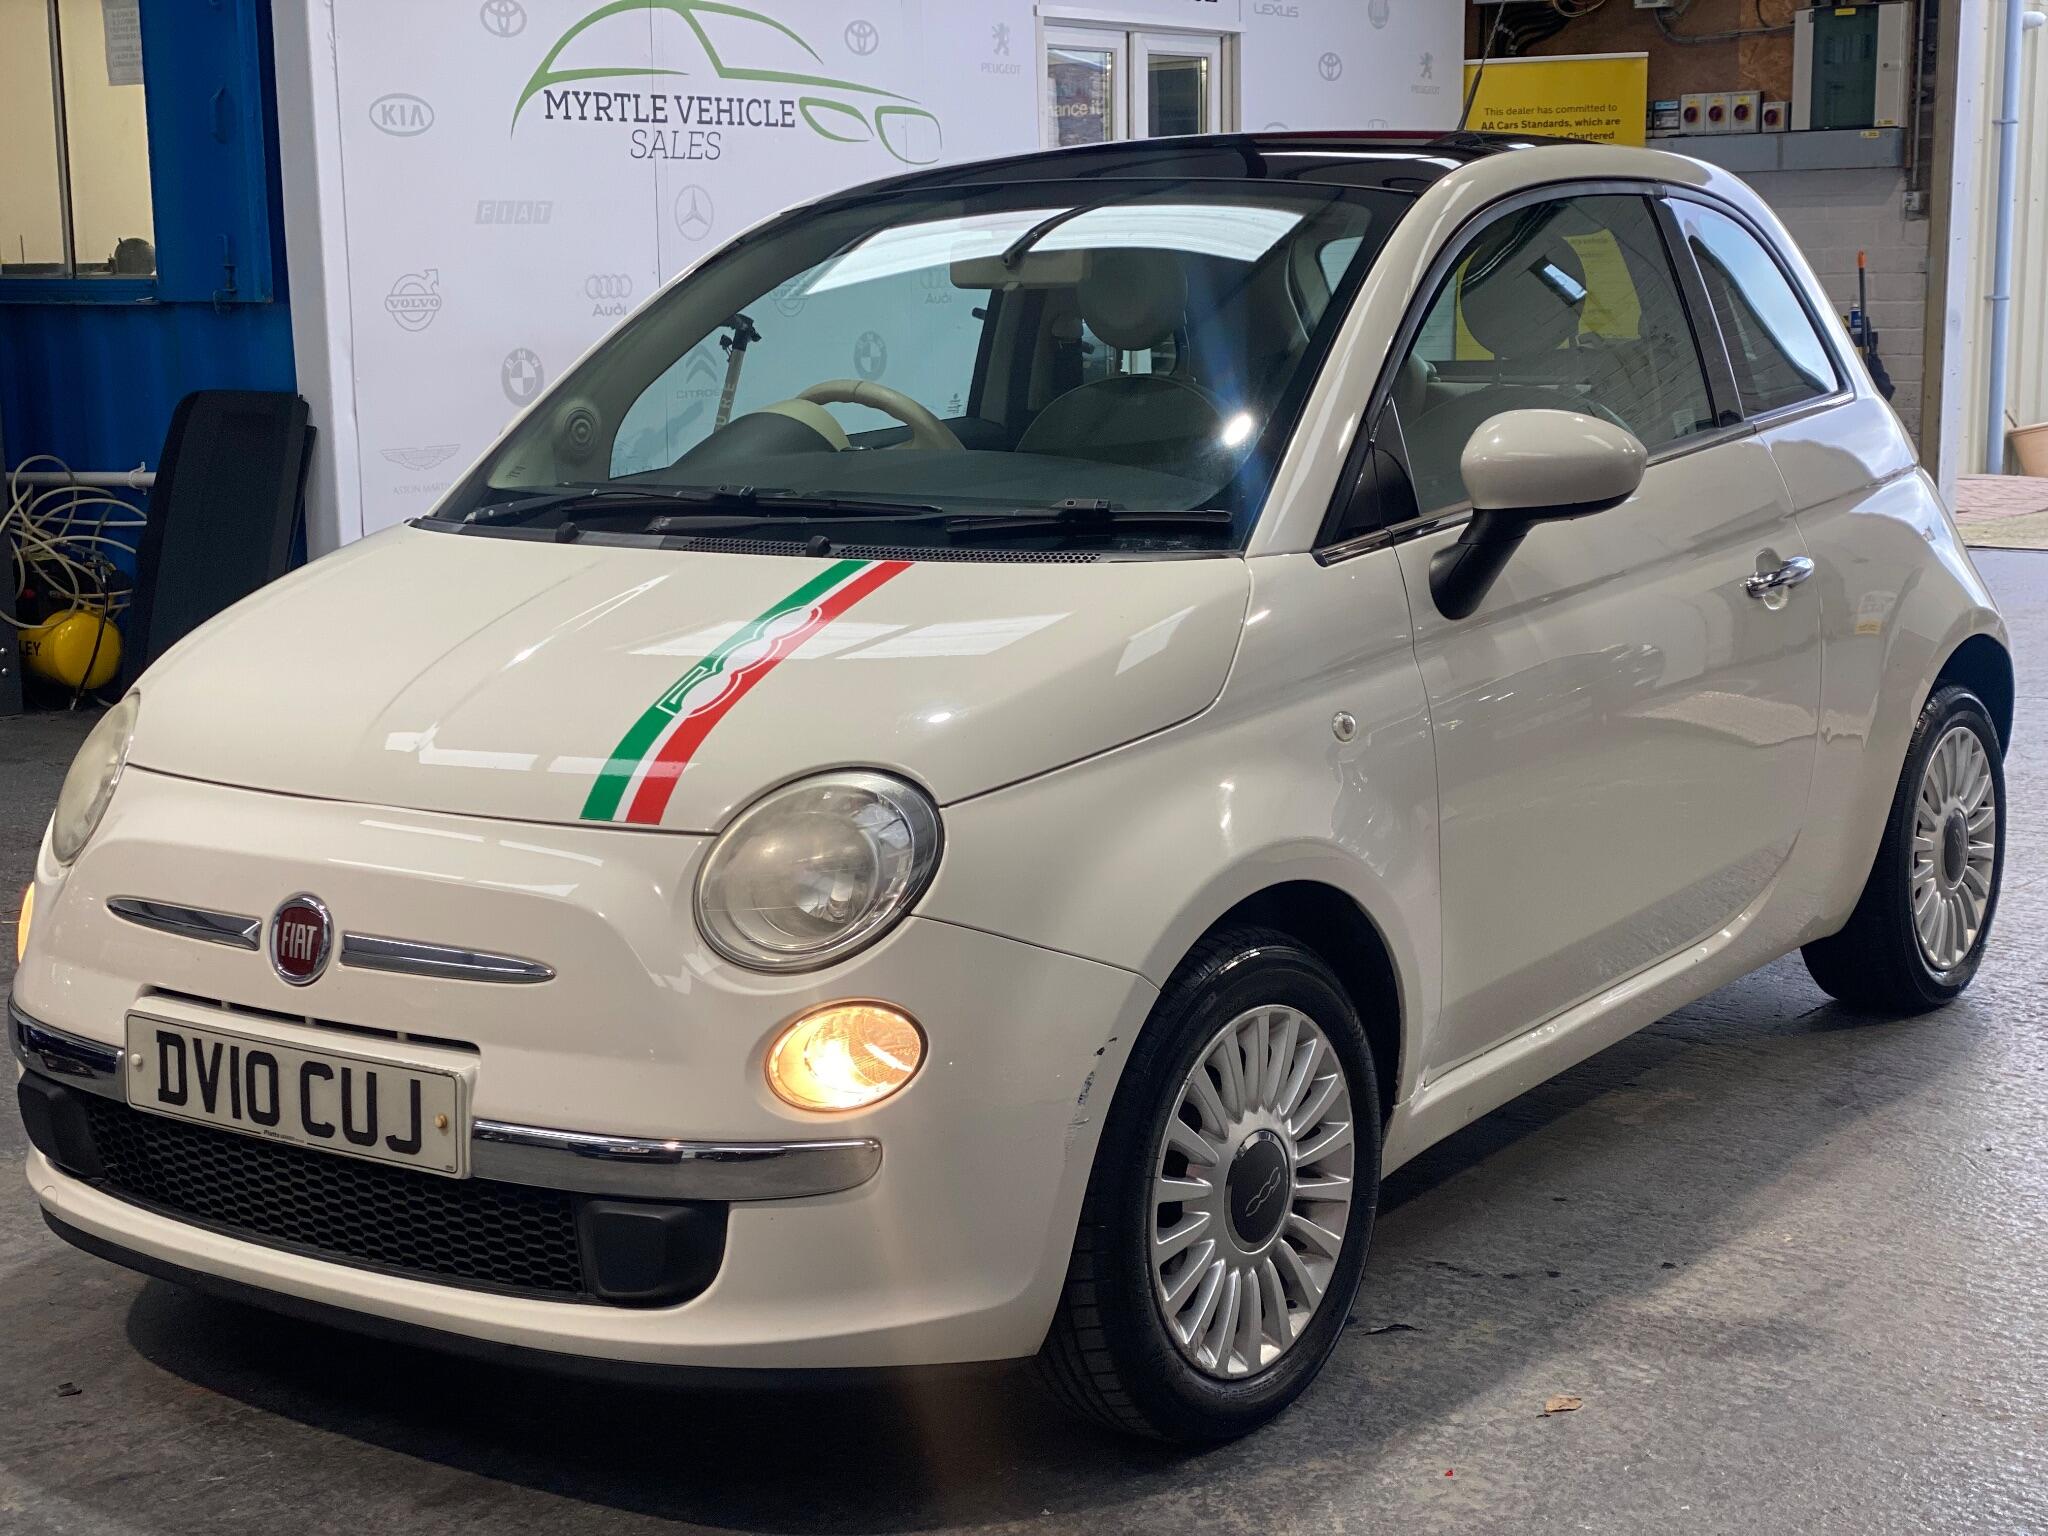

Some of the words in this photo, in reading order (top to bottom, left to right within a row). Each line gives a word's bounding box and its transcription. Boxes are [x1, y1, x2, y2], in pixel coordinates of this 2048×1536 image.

[1254, 2, 1299, 18] LEXUS
[981, 63, 1021, 75] PEUGEOT
[381, 104, 425, 127] KIA
[543, 89, 668, 123] MYRTLE
[673, 94, 796, 128] VEHICLE
[1484, 107, 1504, 116] This
[1505, 106, 1535, 116] dealer
[1537, 104, 1553, 115] has
[1555, 103, 1606, 115] committed
[1607, 103, 1618, 112] to
[1481, 121, 1495, 130] AA
[1496, 120, 1519, 130] Cars
[1520, 119, 1573, 129] Standards,
[1574, 118, 1603, 127] which
[1605, 118, 1621, 126] are
[630, 128, 722, 161] SALES
[480, 202, 551, 222] FIAT
[389, 298, 439, 309] VOLVO
[591, 302, 628, 317] Audi
[504, 350, 542, 369] BMW
[281, 921, 318, 961] FIAT
[156, 1029, 281, 1127] DV10
[299, 1060, 422, 1155] CUJ
